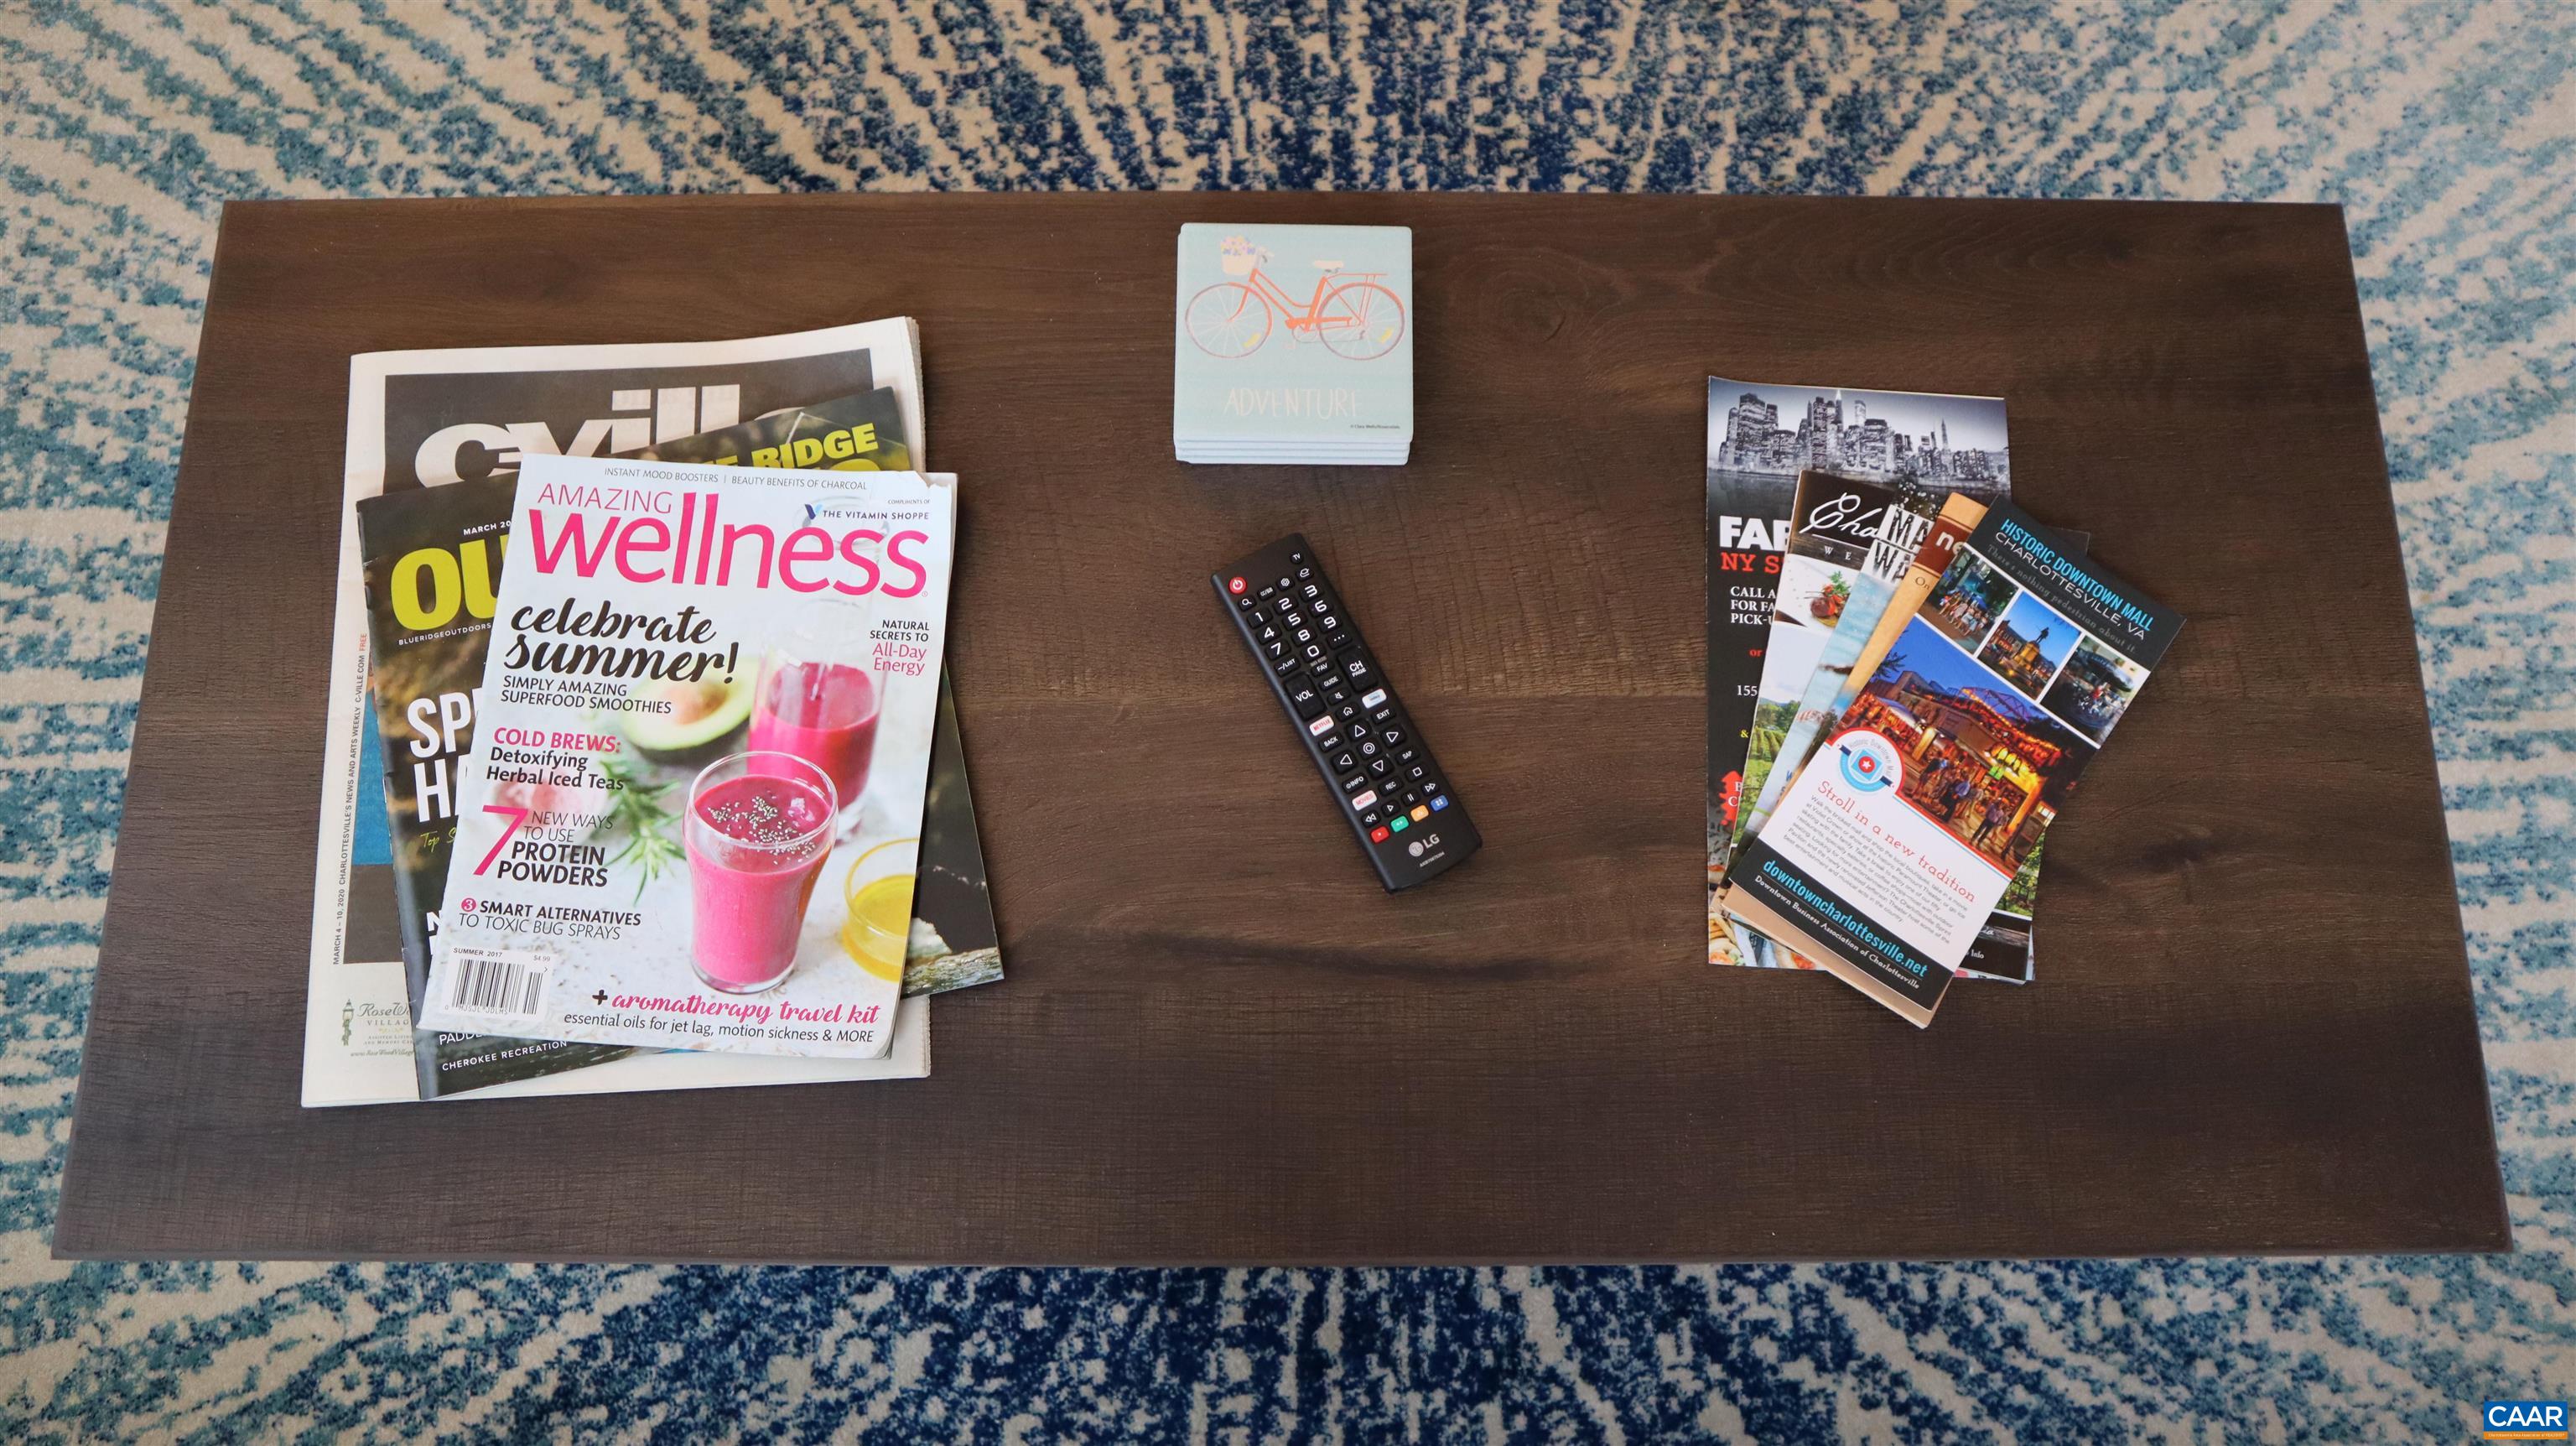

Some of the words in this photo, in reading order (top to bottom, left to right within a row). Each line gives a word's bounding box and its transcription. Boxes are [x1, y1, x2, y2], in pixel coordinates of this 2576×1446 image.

[751, 423, 878, 468] RIDGE
[604, 467, 640, 477] INSTANT
[642, 469, 673, 480] MOOD
[675, 471, 719, 483] BOOSTERS
[731, 475, 765, 486] BEAUTY
[766, 477, 805, 488] BENEFITS
[808, 479, 818, 488] OF
[821, 480, 867, 491] CHARCOAL
[538, 482, 673, 514] AMAZING
[823, 509, 841, 518] THE
[845, 510, 888, 520] VITAMIN
[891, 512, 929, 520] SHOPPE
[463, 522, 497, 536] MARCH
[528, 492, 929, 599] wellness
[1721, 552, 1756, 572] NY
[1764, 554, 1784, 574] S
[2001, 518, 2054, 563] HISTORIC
[2052, 556, 2123, 610] DOWNTOWN
[2121, 602, 2153, 631] MALL
[1305, 585, 1317, 597] 3
[1730, 586, 1765, 598] CALL
[1995, 532, 2121, 626] CHARLOTTESVILLE,
[2128, 622, 2143, 640] VA
[1279, 598, 1292, 610] 2
[1315, 600, 1327, 612] 6
[1730, 600, 1758, 611] FOR
[511, 597, 716, 643] celebrate
[882, 619, 930, 631] NATURAL
[1255, 612, 1264, 622] 1
[1288, 613, 1301, 626] 5
[1324, 616, 1336, 629] 9
[870, 630, 911, 641] SECRETS
[915, 632, 929, 642] TO
[1264, 627, 1275, 638] 4
[1297, 629, 1310, 642] 8
[504, 634, 739, 684] summer!
[872, 642, 927, 661] All-Day
[1270, 642, 1281, 655] 7
[874, 657, 925, 676] Energy
[1317, 663, 1327, 672] FAV
[1349, 660, 1363, 672] CH
[503, 675, 554, 692] SIMPLY
[558, 680, 627, 697] AMAZING
[1296, 690, 1313, 702] VOL
[501, 689, 585, 709] SUPERFOOD
[589, 696, 672, 714] SMOOTHIES
[407, 687, 484, 758] SP
[1376, 709, 1390, 720] EXIT
[494, 726, 545, 747] COLD
[550, 731, 621, 753] BREWS:
[1323, 736, 1338, 746] BACK
[490, 746, 589, 772] Detoxifying
[486, 765, 543, 785] Herbal
[548, 770, 582, 788] Iced
[588, 773, 624, 791] Teas
[1385, 781, 1397, 791] REC
[531, 810, 570, 826] NEW
[572, 814, 614, 830] WAYS
[332, 934, 340, 965] MARCH
[345, 779, 354, 803] NEWS
[351, 706, 360, 736] WEEKLY
[473, 804, 528, 876] 7
[523, 826, 543, 840] TO
[548, 828, 575, 842] USE
[1423, 834, 1441, 849] LG
[1817, 780, 1855, 813] Stroll
[1854, 810, 1868, 825] in
[1872, 825, 1881, 835] a
[1884, 834, 1914, 856] new
[1918, 855, 1974, 902] tradition
[511, 841, 605, 866] PROTEIN
[497, 861, 609, 887] POWDERS
[464, 899, 474, 911] 3
[480, 901, 533, 918] SMART
[537, 906, 641, 926] ALTERNATIVES
[1763, 860, 1927, 976] downtowncharlottesville.net
[459, 913, 479, 928] TO
[486, 915, 528, 933] TOXIC
[533, 921, 564, 936] BUG
[568, 923, 621, 940] SPRAYS
[1754, 875, 1791, 905] Downtown
[1792, 902, 1819, 924] Business
[1820, 923, 1858, 950] Association
[1868, 954, 1919, 988] Charlottesville
[453, 947, 484, 956] SUMMER
[611, 992, 774, 1025] aromatherapy
[778, 1001, 843, 1023] travel
[847, 1004, 880, 1024] kit
[564, 1011, 620, 1027] essential
[623, 1014, 646, 1029] oils
[649, 1016, 667, 1030] for
[669, 1017, 688, 1034] jet
[692, 1020, 714, 1038] lag,
[719, 1023, 765, 1038] motion
[767, 1026, 818, 1042] sickness
[823, 1028, 833, 1042] &
[836, 1029, 874, 1043] MORE
[442, 1053, 497, 1071] CHEROKEE
[501, 1041, 567, 1059] RECREATION
